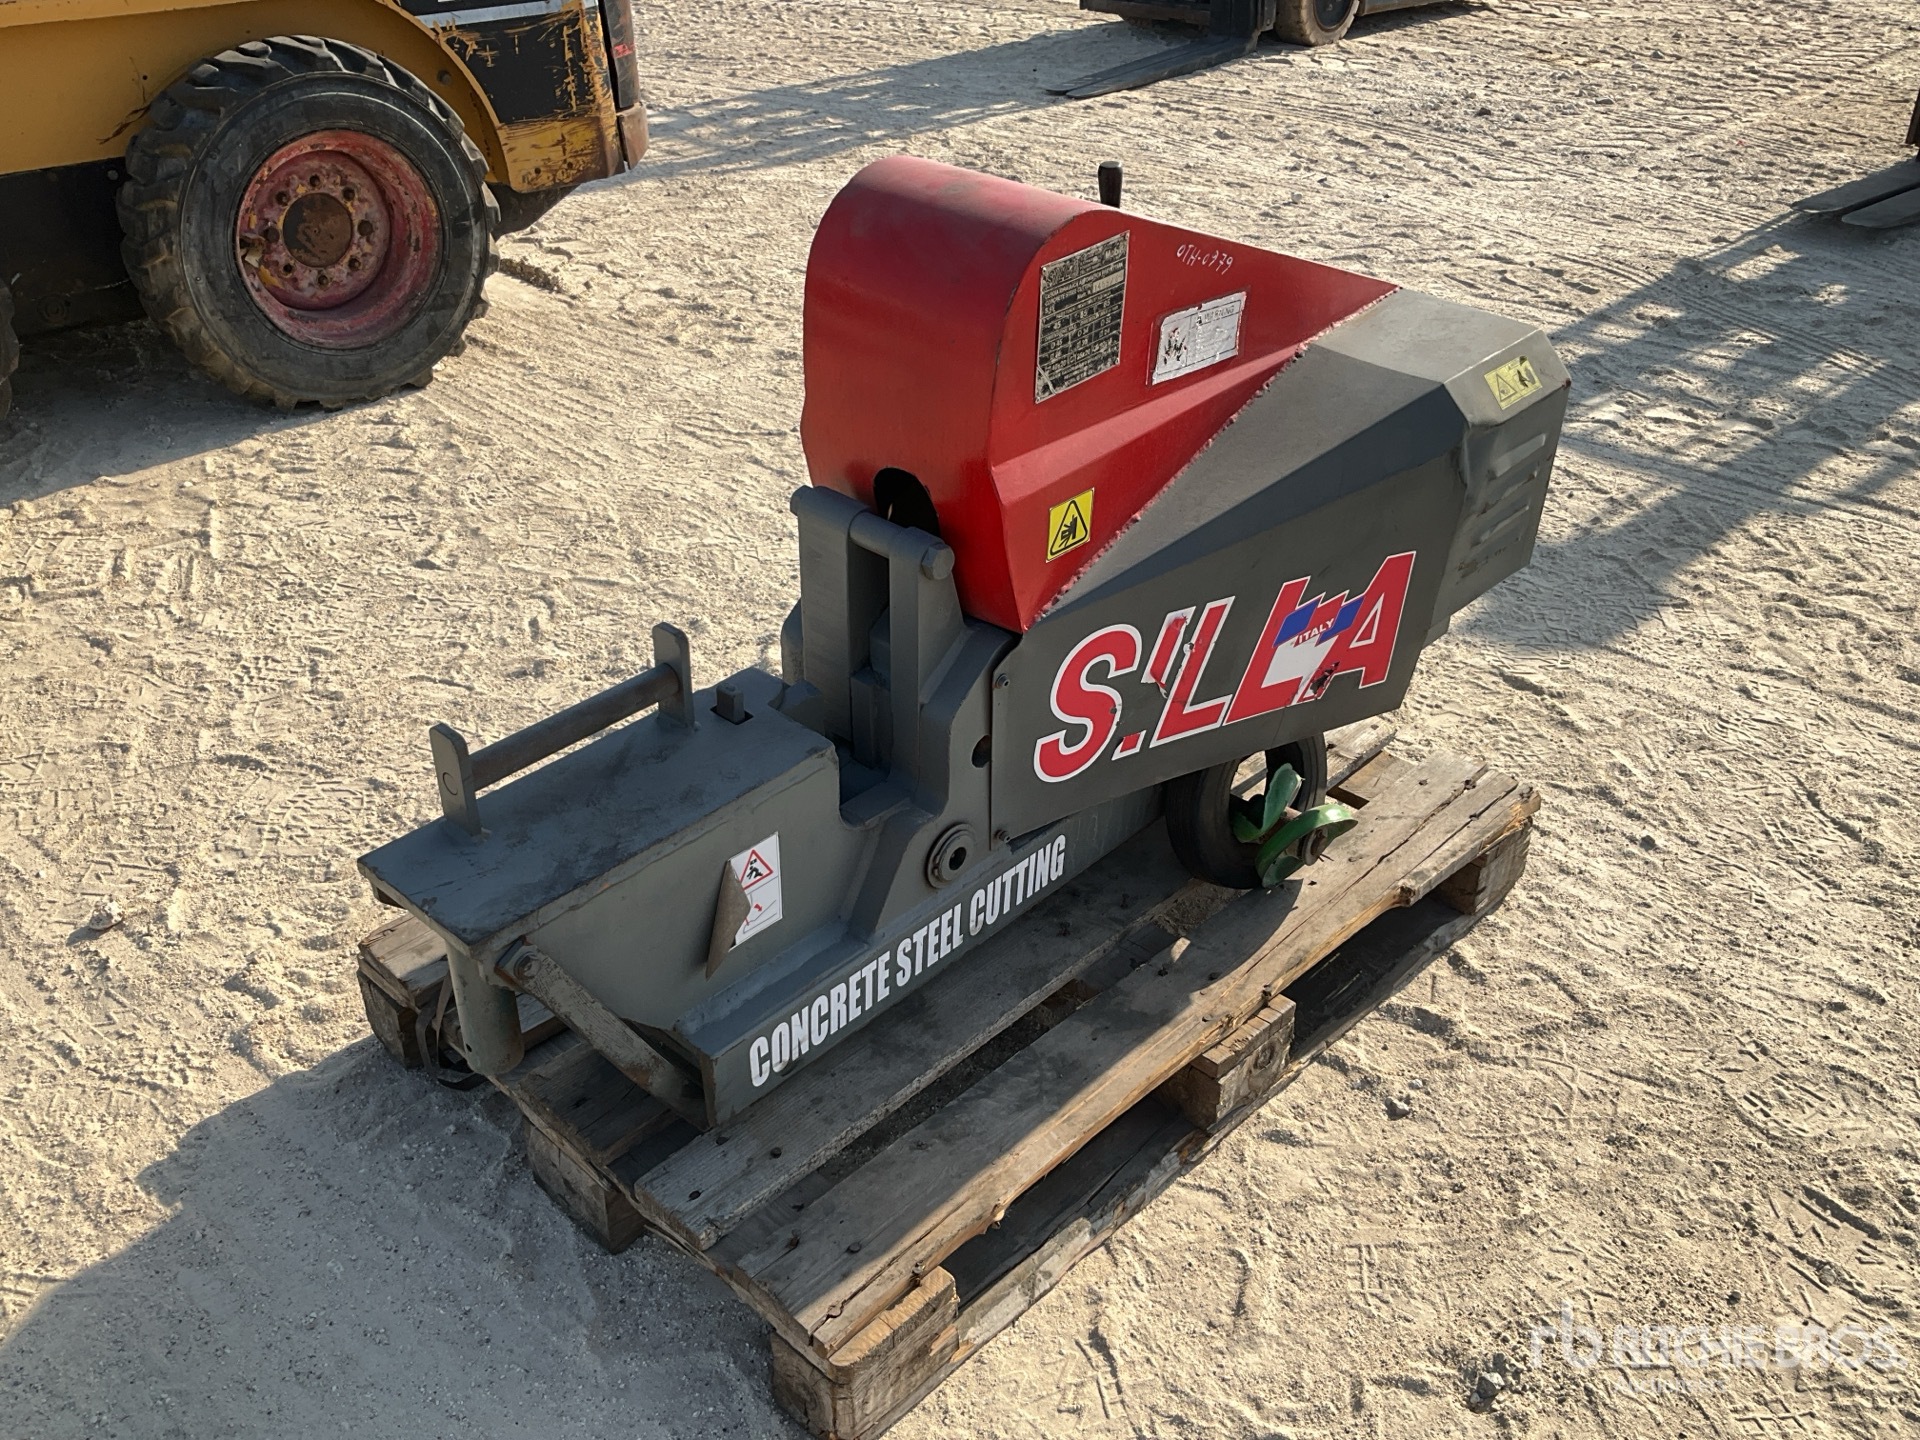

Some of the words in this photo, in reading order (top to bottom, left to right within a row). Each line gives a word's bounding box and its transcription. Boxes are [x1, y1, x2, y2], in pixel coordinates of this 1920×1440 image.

[1298, 617, 1335, 644] ITALY
[749, 951, 890, 1087] CONCRETE
[895, 903, 963, 986] STEEL
[969, 834, 1066, 936] CUTTING
